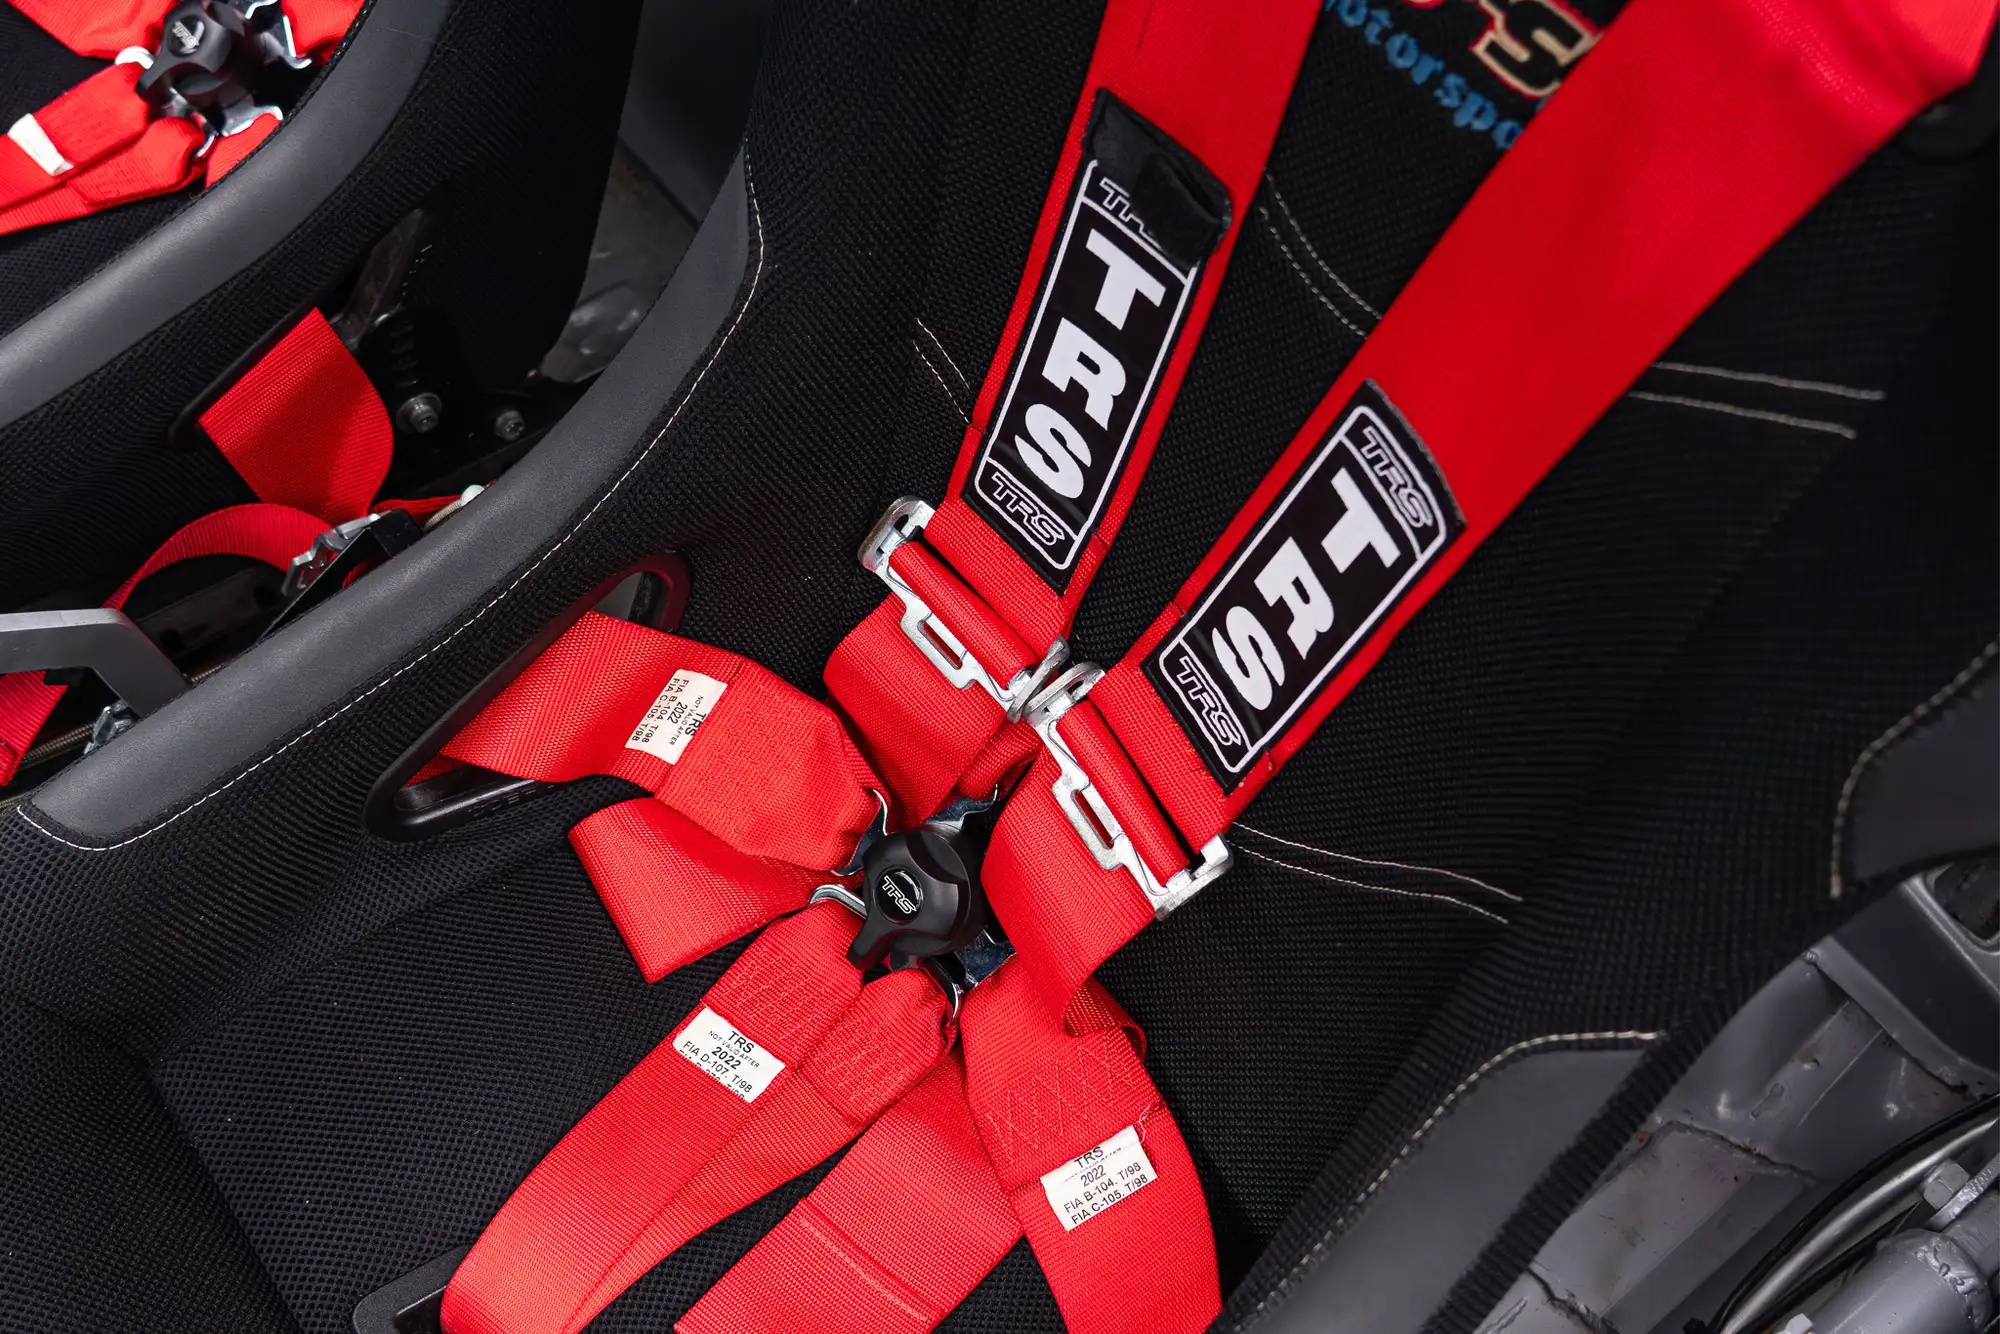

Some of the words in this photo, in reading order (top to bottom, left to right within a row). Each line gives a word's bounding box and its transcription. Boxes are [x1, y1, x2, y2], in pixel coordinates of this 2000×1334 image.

[1323, 0, 1523, 149] otorspo
[1014, 228, 1166, 499] TRS
[1361, 426, 1434, 529] TRS
[991, 471, 1066, 547] TRS
[1212, 467, 1401, 711] TRS
[665, 677, 680, 693] FIA
[675, 679, 690, 693] FIA
[667, 701, 688, 724] 2022
[694, 695, 704, 709] NOT
[1176, 655, 1242, 746] TRS
[682, 709, 696, 726] VALID
[685, 712, 707, 736] TRS
[631, 722, 649, 741] T/98
[641, 724, 659, 743] T/98
[669, 726, 684, 745] AFTER
[882, 875, 917, 914] TRS
[708, 1030, 722, 1042] NOT
[722, 1040, 740, 1055] VALID
[740, 1053, 760, 1068] AFTER
[728, 1030, 755, 1053] TRS
[683, 1040, 700, 1056] FIA
[700, 1053, 729, 1078] D-107.
[731, 1074, 753, 1093] T/98
[711, 1046, 742, 1070] 2022
[1073, 1146, 1104, 1168] TRS
[1063, 1197, 1084, 1213] FIA
[1083, 1178, 1118, 1202] B-104.
[1117, 1162, 1142, 1181] T/98
[1080, 1164, 1106, 1188] 2022
[1071, 1208, 1091, 1225] FIA
[1124, 1173, 1149, 1193] T/98
